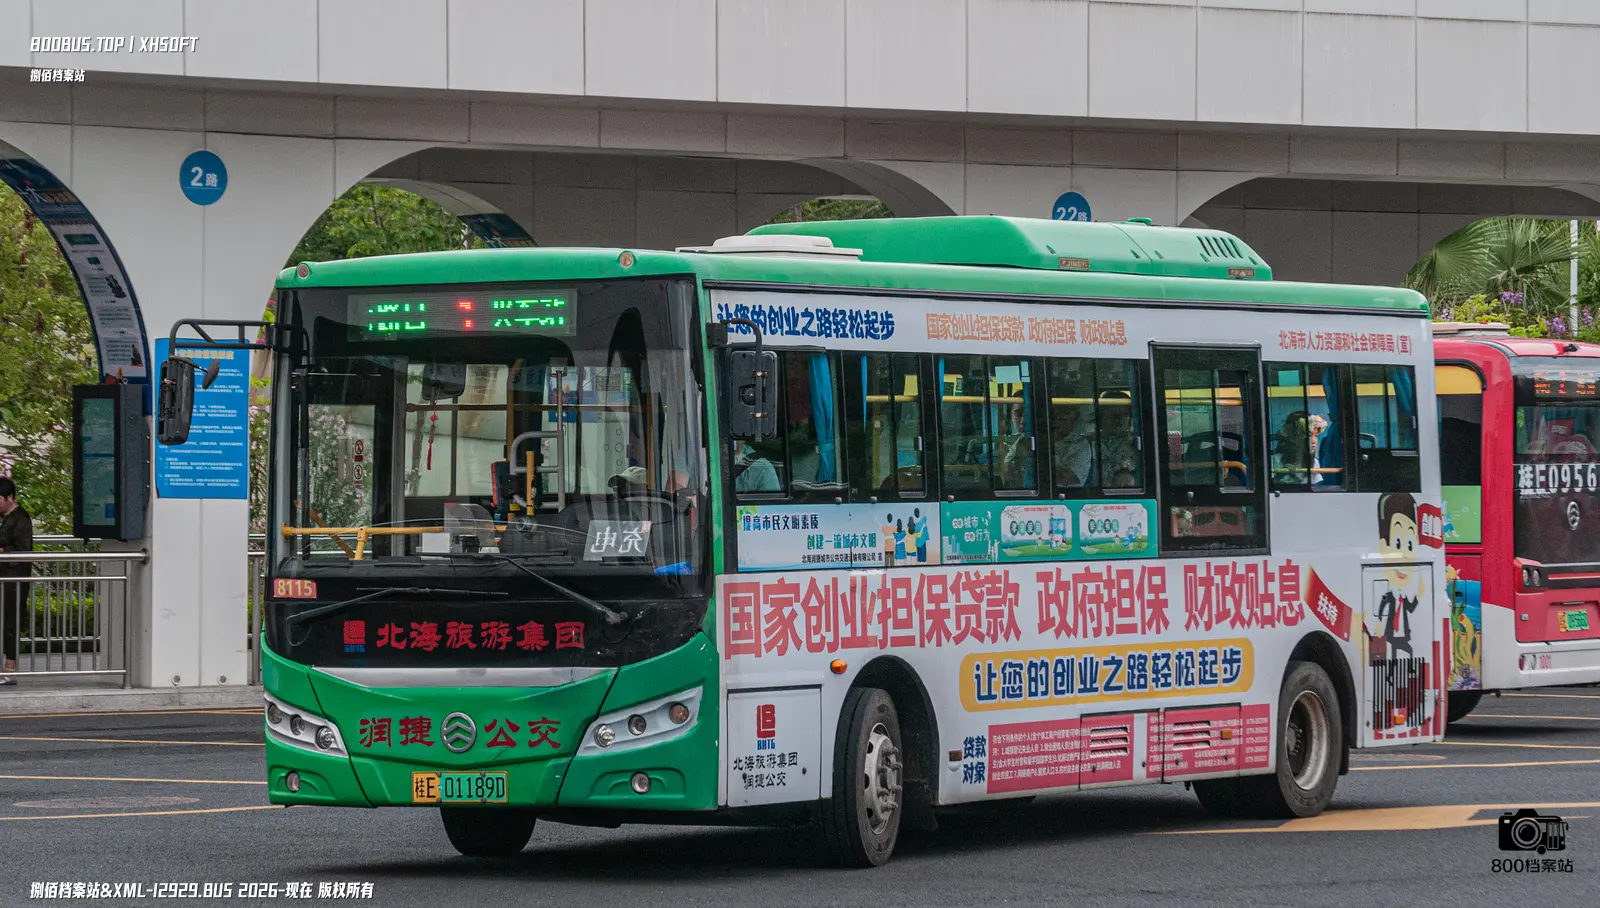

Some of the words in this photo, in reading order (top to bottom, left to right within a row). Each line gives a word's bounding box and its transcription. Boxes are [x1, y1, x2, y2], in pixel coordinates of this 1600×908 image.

[190, 166, 218, 187] 2路
[716, 303, 895, 341] 让您的创业之路轻松起步
[926, 312, 1025, 343] 国家创业担保贷款
[1028, 317, 1078, 345] 政府担保
[1080, 319, 1128, 346] 财政贴息
[743, 513, 819, 532] 提高市民文明素质
[807, 533, 877, 550] 创建一流城市文明
[277, 579, 313, 597] 8115
[723, 568, 1022, 660] 国家创业担保贷款
[1036, 565, 1170, 640] 政府担保
[1184, 558, 1306, 632] 财政贴息
[376, 621, 585, 650] 北海旅游集团
[974, 647, 1243, 702] 让您的创业之路轻松起步
[359, 717, 436, 748] 润捷
[484, 717, 562, 748] 公交
[962, 735, 987, 759] 贷款
[733, 751, 798, 771] 北海旅游集团
[962, 761, 986, 784] 对象
[415, 776, 505, 799] 桂E01189D
[743, 771, 787, 790] 润捷公交
